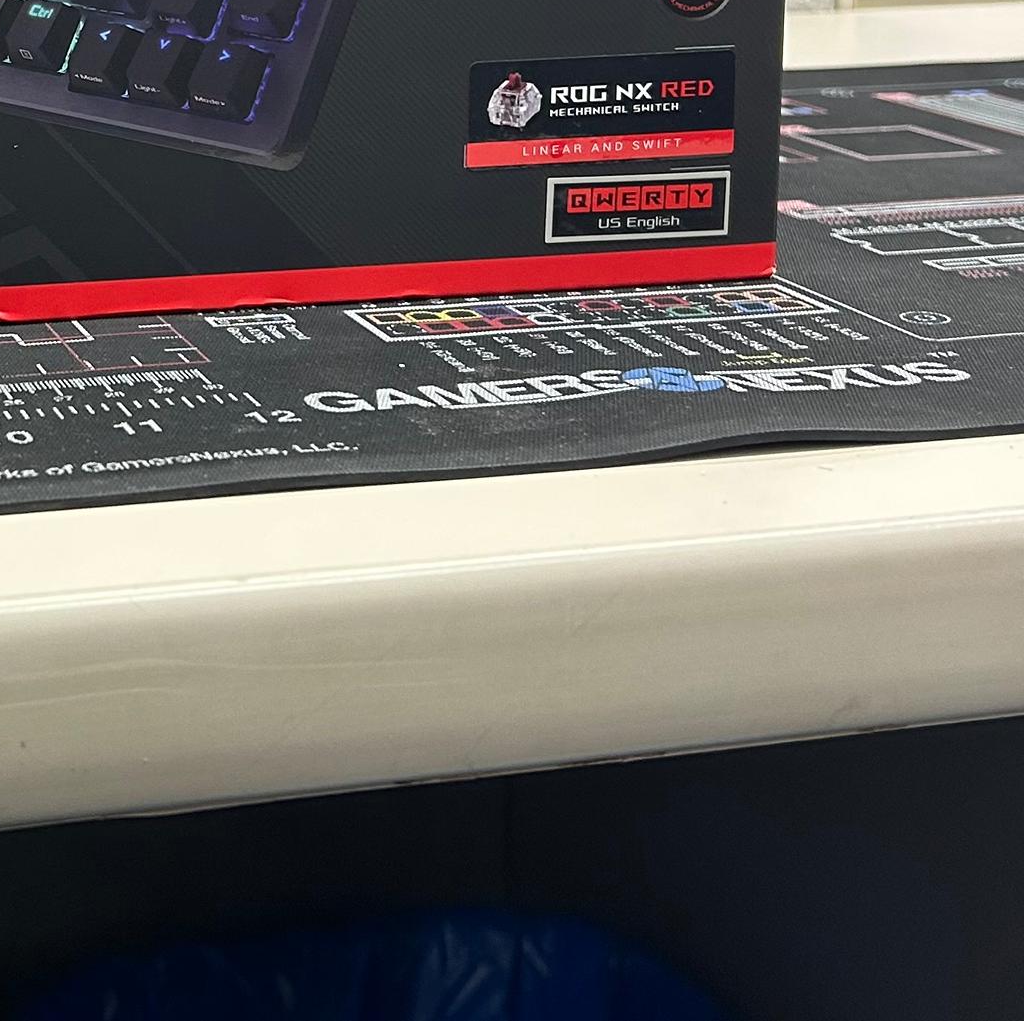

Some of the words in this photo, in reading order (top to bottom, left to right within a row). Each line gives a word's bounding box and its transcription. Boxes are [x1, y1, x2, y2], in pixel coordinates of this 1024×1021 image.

[28, 4, 54, 19] Ctrl
[550, 84, 608, 105] ROG
[616, 82, 653, 101] NX
[661, 79, 715, 98] RED
[549, 106, 629, 118] MECHANICAL
[632, 102, 680, 114] SWITCH
[522, 144, 583, 157] LINEAR
[590, 142, 624, 153] AND
[632, 138, 683, 150] SWIFT
[569, 186, 712, 211] QWERTY
[598, 217, 621, 229] US
[626, 216, 681, 230] English
[304, 369, 627, 413] GAMERS
[717, 359, 972, 394] NEXUS
[113, 419, 164, 436] 11
[244, 409, 303, 426] 12
[45, 460, 75, 476] of
